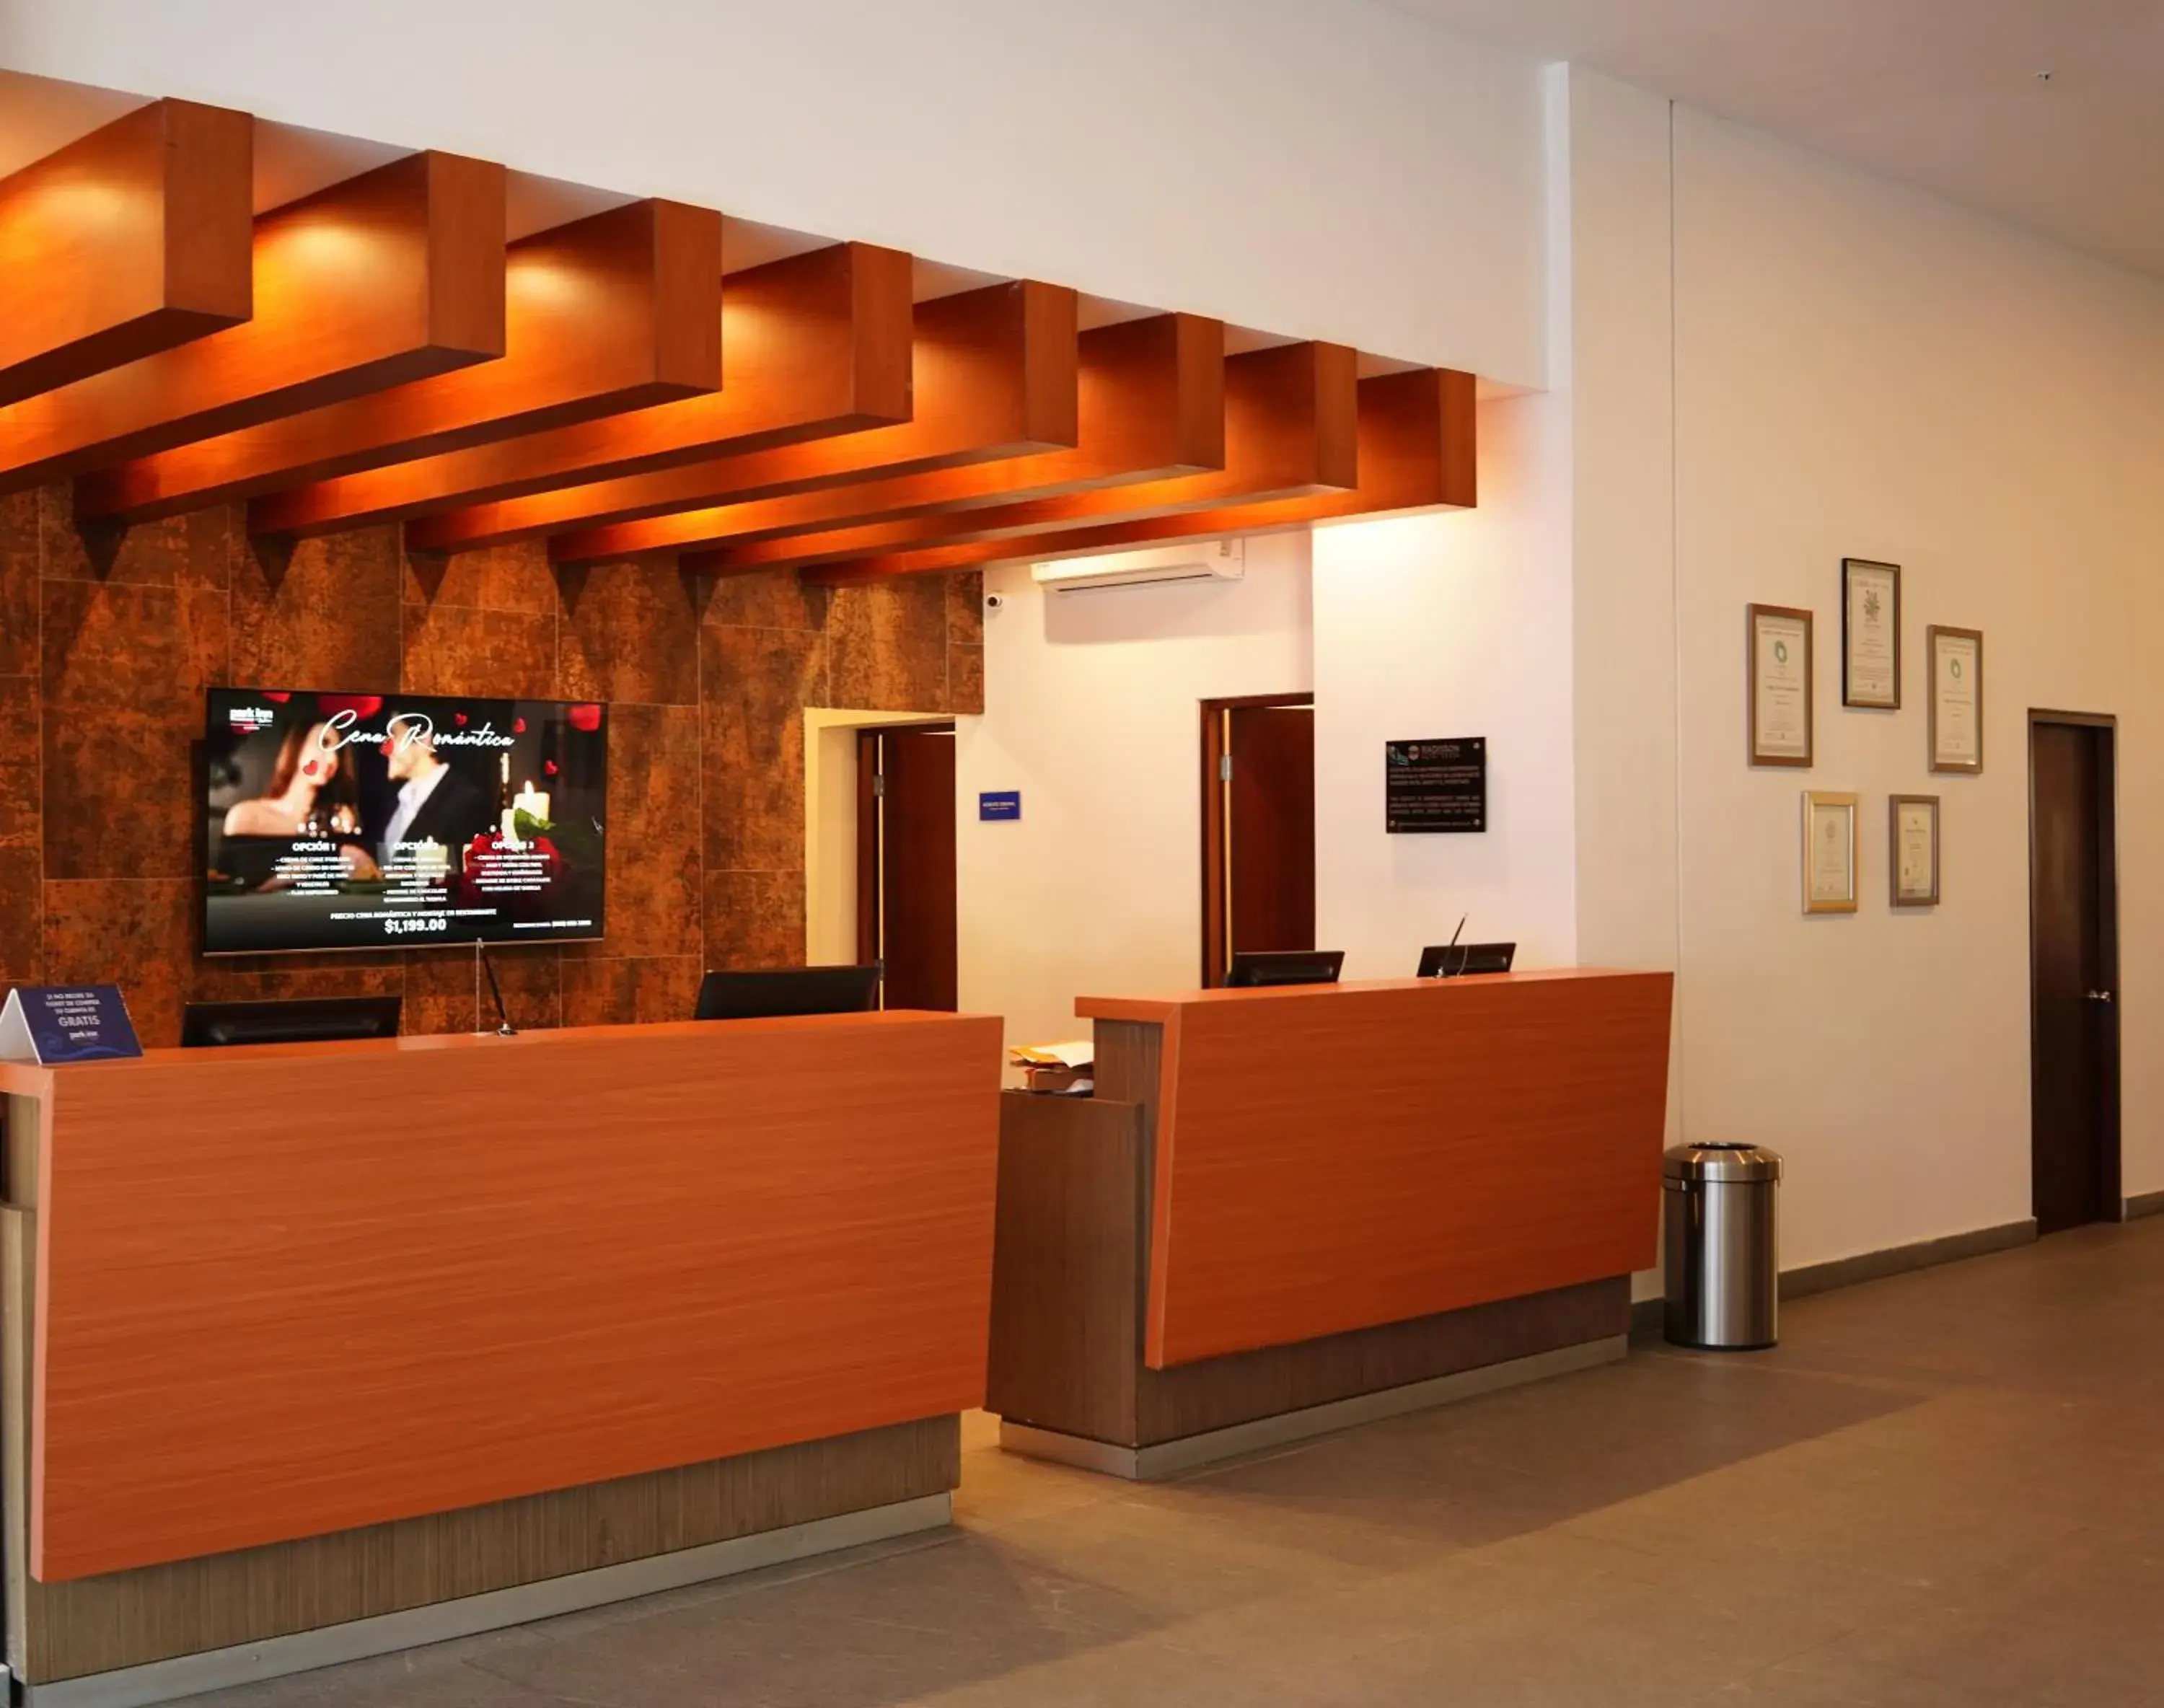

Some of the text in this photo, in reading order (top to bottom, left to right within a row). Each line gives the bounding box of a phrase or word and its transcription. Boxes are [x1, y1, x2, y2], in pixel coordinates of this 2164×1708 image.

[319, 709, 386, 752] Cena
[292, 841, 330, 851] OPCIÓN
[384, 918, 447, 934] $1,199.00
[58, 1015, 101, 1027] GRATIS
